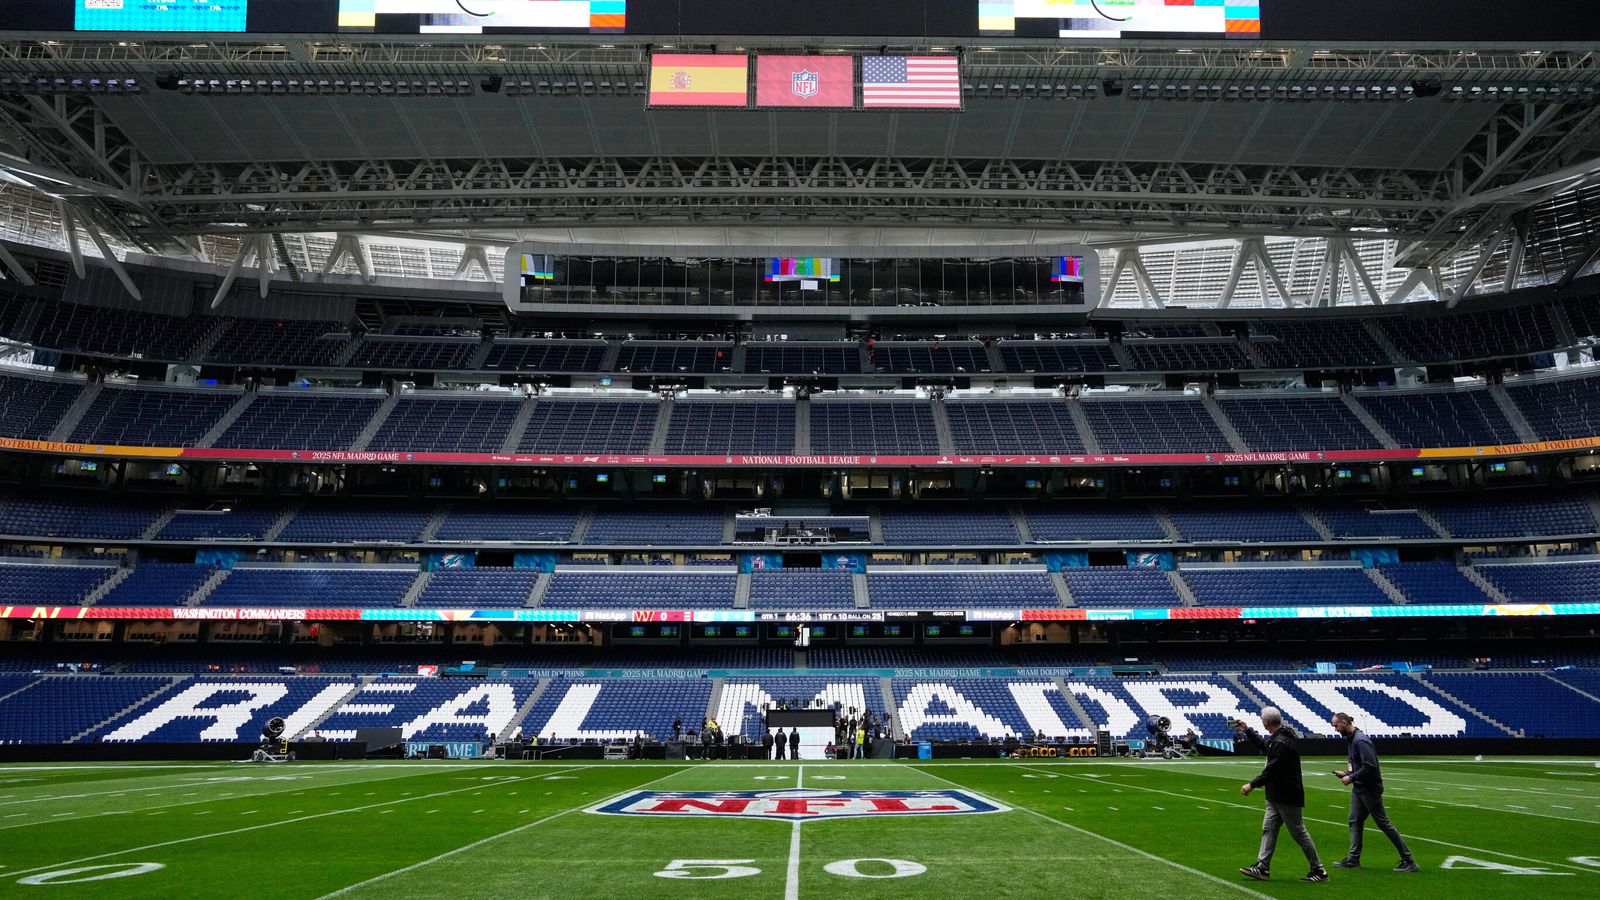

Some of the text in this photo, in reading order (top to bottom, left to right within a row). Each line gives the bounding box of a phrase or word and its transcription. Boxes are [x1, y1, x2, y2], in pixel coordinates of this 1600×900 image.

[796, 82, 816, 94] NFL
[47, 442, 86, 454] LEAGUE
[1494, 438, 1597, 455] NATIONAL FOOTBALL
[312, 452, 400, 461] 2025 NFL MADRID GAME
[742, 456, 860, 464] NATIONAL FOOTBALL LEAGUE
[1224, 452, 1310, 462] 2025 NFL MADRID GAME
[173, 608, 306, 620] WASHINGTON COMMANDERS
[594, 612, 627, 621] NetApp
[785, 612, 812, 621] 66:36
[983, 611, 1015, 620] NetApp
[622, 669, 641, 678] 2025
[641, 669, 655, 678] NFL
[656, 669, 686, 678] MADRID
[895, 669, 981, 678] 2025 NFL MADRID GAME
[1017, 668, 1039, 676] MIAMI
[102, 679, 1468, 743] REAL MADRID
[635, 798, 961, 815] NFL
